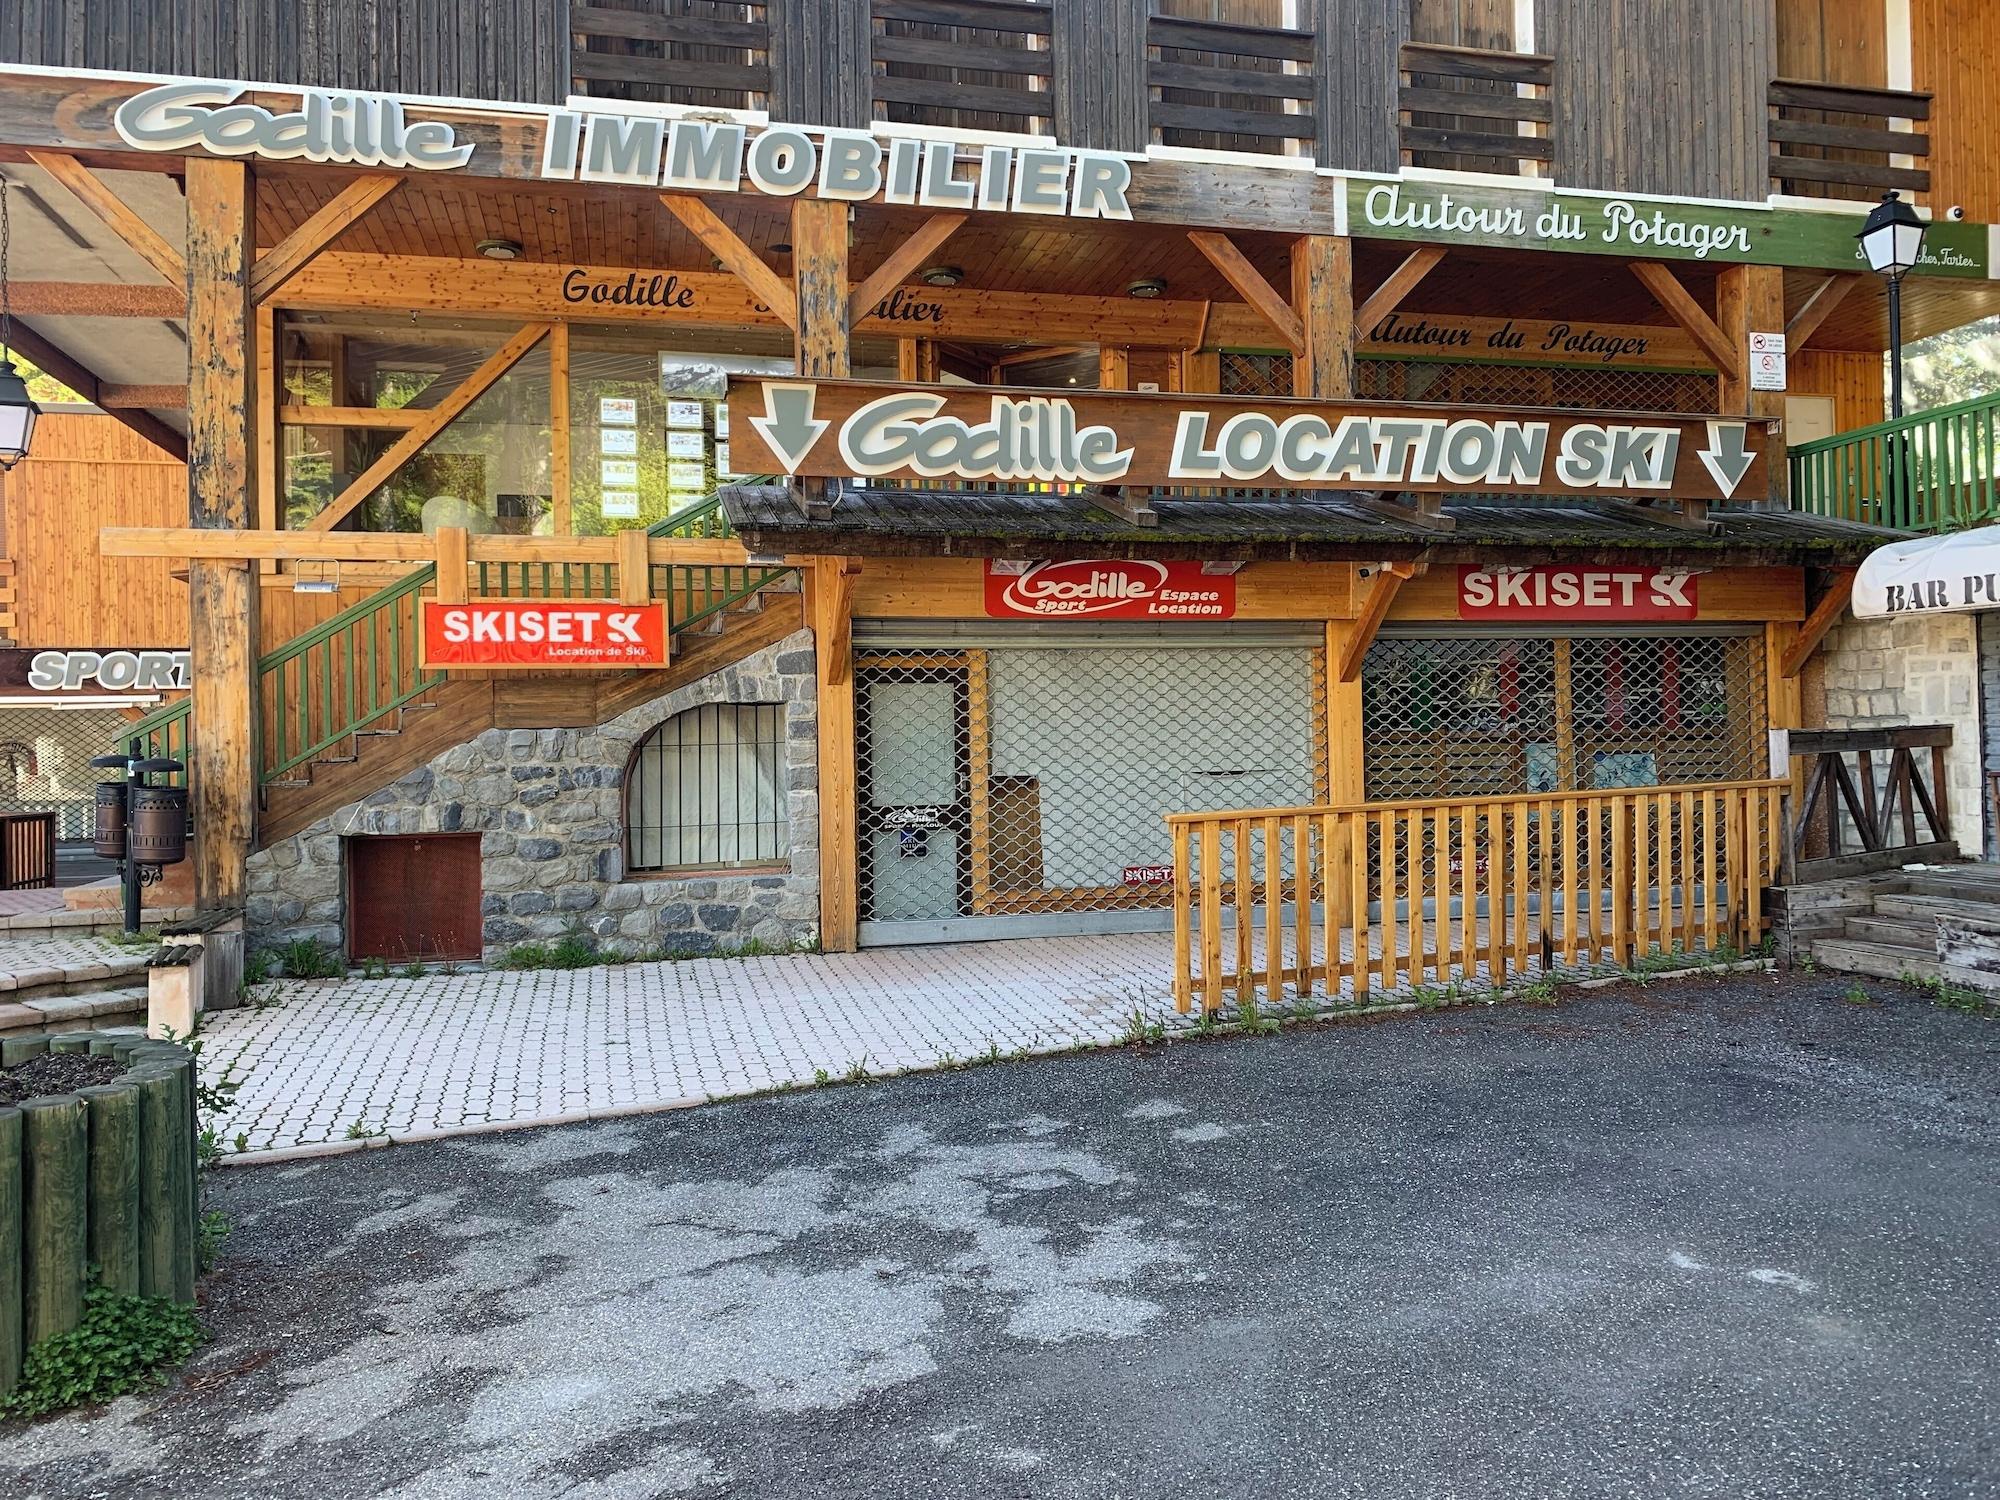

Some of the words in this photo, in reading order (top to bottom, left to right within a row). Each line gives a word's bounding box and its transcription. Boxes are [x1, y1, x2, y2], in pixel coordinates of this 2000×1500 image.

[115, 85, 475, 170] Godille
[541, 111, 1134, 220] IMMOBILIER
[1365, 184, 1526, 236] Autour
[1535, 203, 1587, 241] du
[1602, 200, 1752, 260] Potager
[563, 269, 695, 309] Godille
[1370, 313, 1471, 347] Autour
[1487, 321, 1524, 349] du
[1541, 323, 1649, 362] Potager
[838, 391, 1136, 483] Godille
[1168, 411, 1550, 486] LOCATION
[1556, 424, 1682, 490] SKI
[1017, 559, 1156, 600] Godille
[1159, 588, 1219, 602] Espace
[1463, 572, 1643, 608] SKISET
[1885, 579, 1950, 612] BAR
[1035, 598, 1088, 612] Sport
[1147, 602, 1223, 615] Location
[443, 610, 601, 643] SKISET
[549, 645, 602, 656] Location
[606, 646, 621, 656] de
